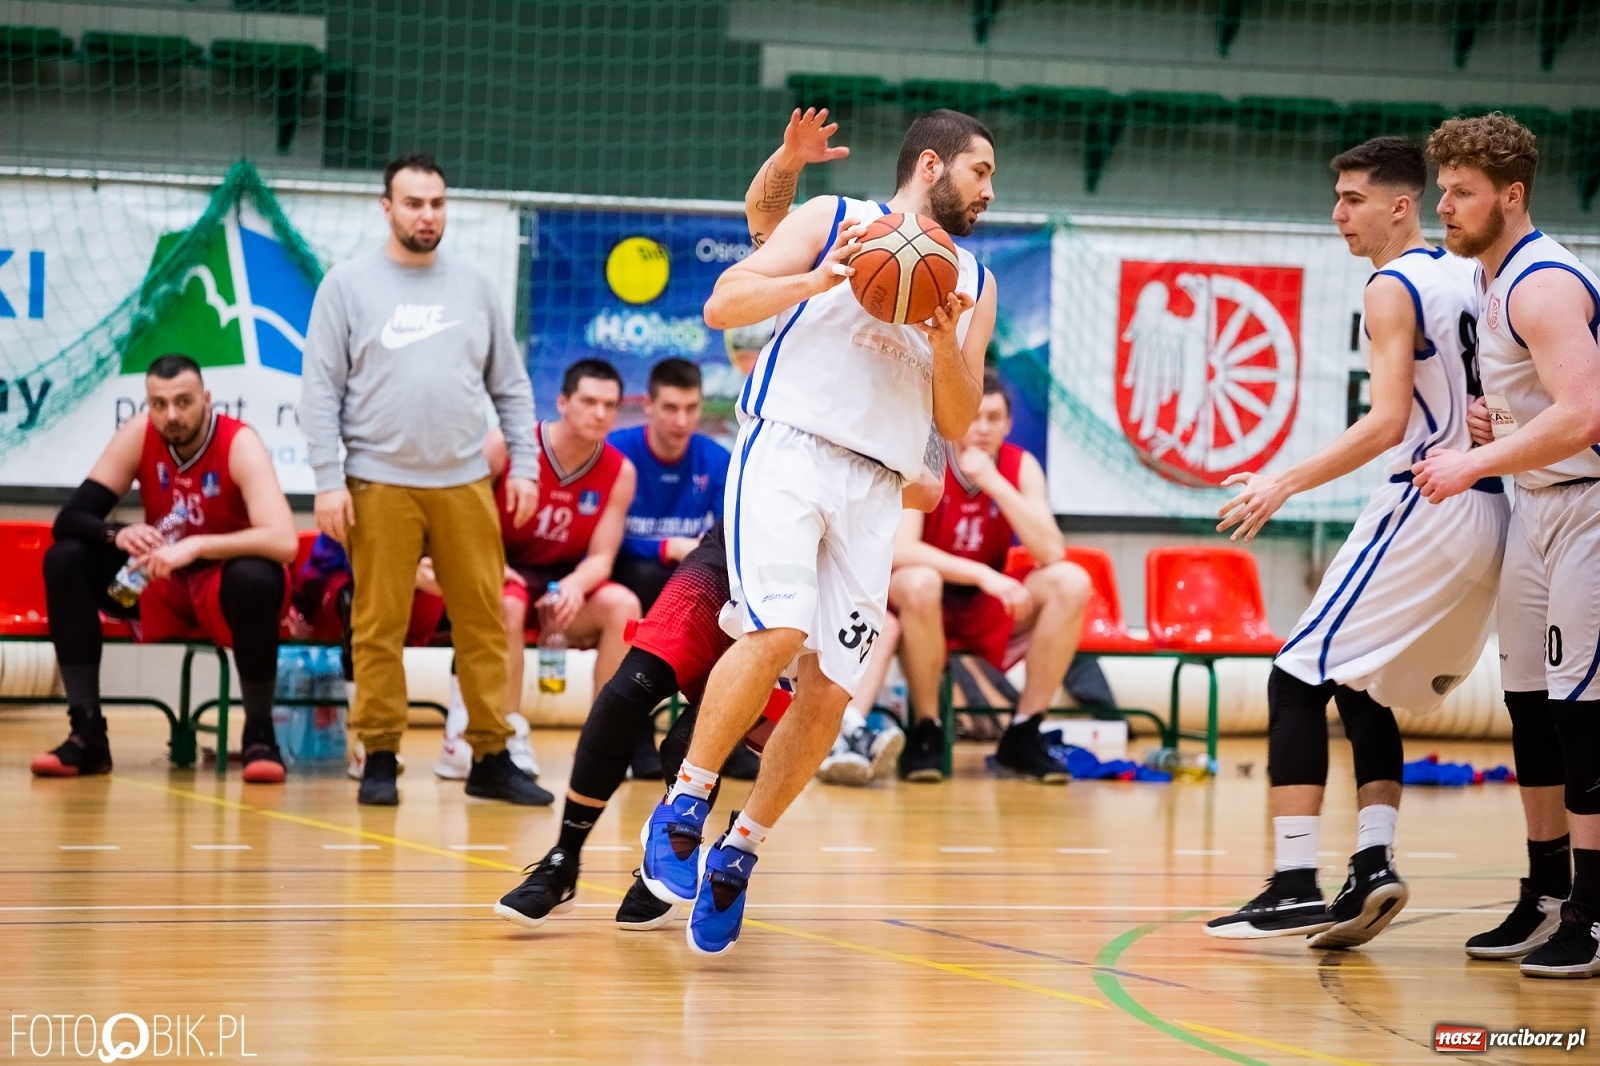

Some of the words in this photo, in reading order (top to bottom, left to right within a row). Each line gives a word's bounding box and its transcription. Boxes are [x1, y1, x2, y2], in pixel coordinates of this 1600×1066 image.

[392, 304, 445, 329] NIKE
[0, 378, 52, 430] y
[534, 504, 573, 543] 12
